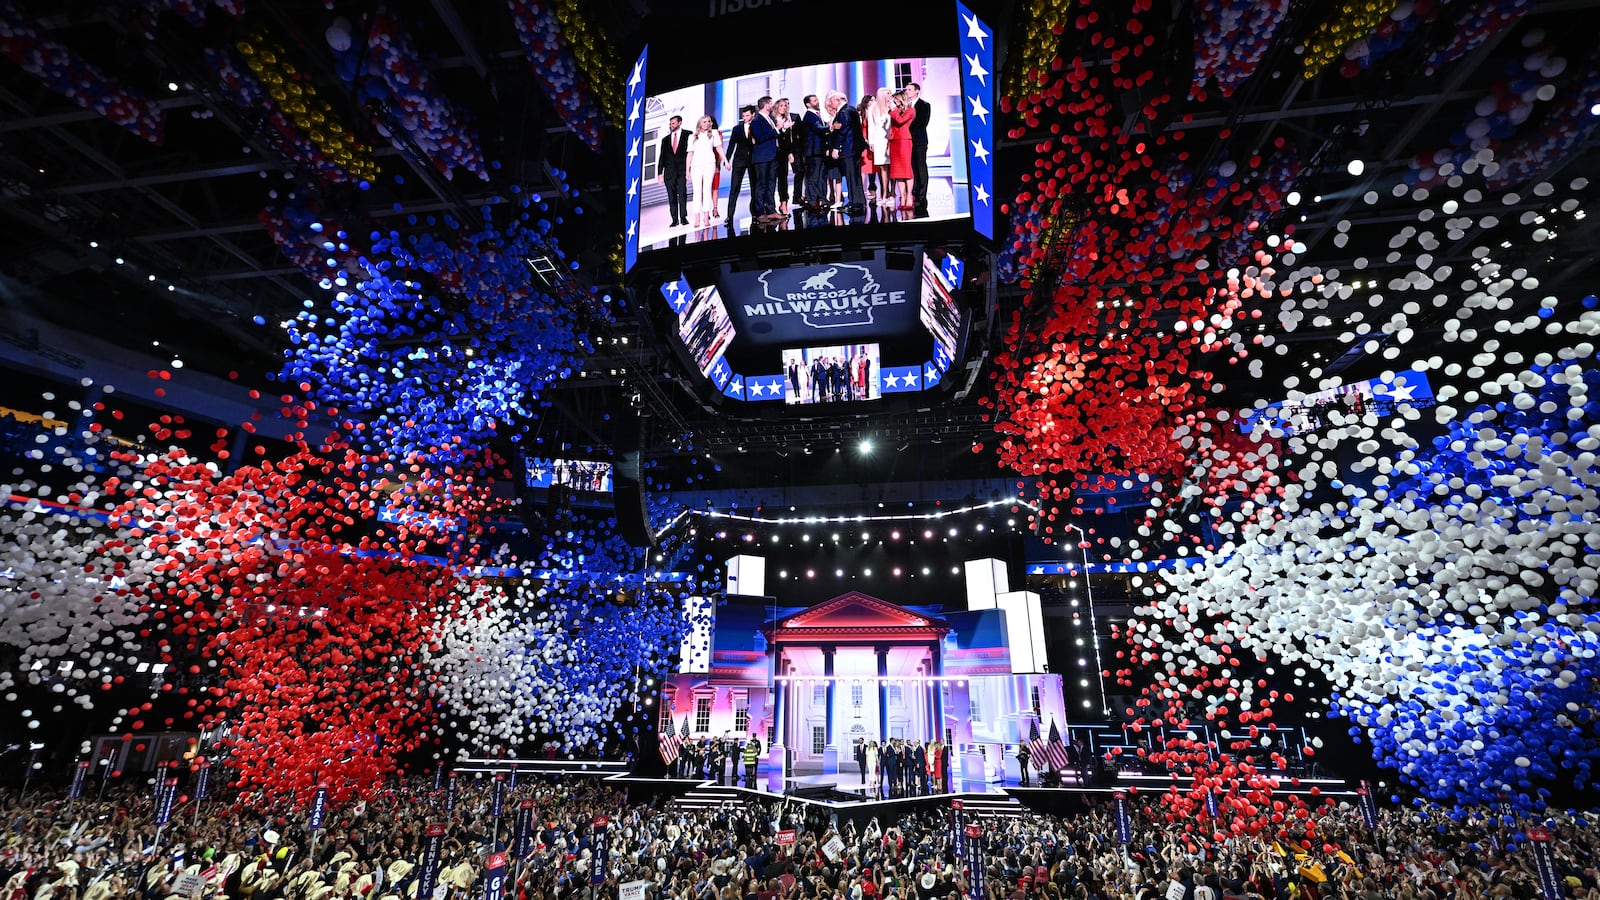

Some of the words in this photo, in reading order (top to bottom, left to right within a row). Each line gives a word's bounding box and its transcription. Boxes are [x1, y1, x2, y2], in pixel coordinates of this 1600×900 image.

[744, 290, 906, 317] MILWAUKEE
[786, 292, 817, 301] RNC
[818, 288, 857, 299] 2024
[312, 791, 325, 825] TEXAS
[422, 837, 437, 895] KENTUCKY
[594, 833, 605, 876] MAINE
[1540, 842, 1561, 900] MINNESOTA
[622, 885, 643, 893] TRUMP
